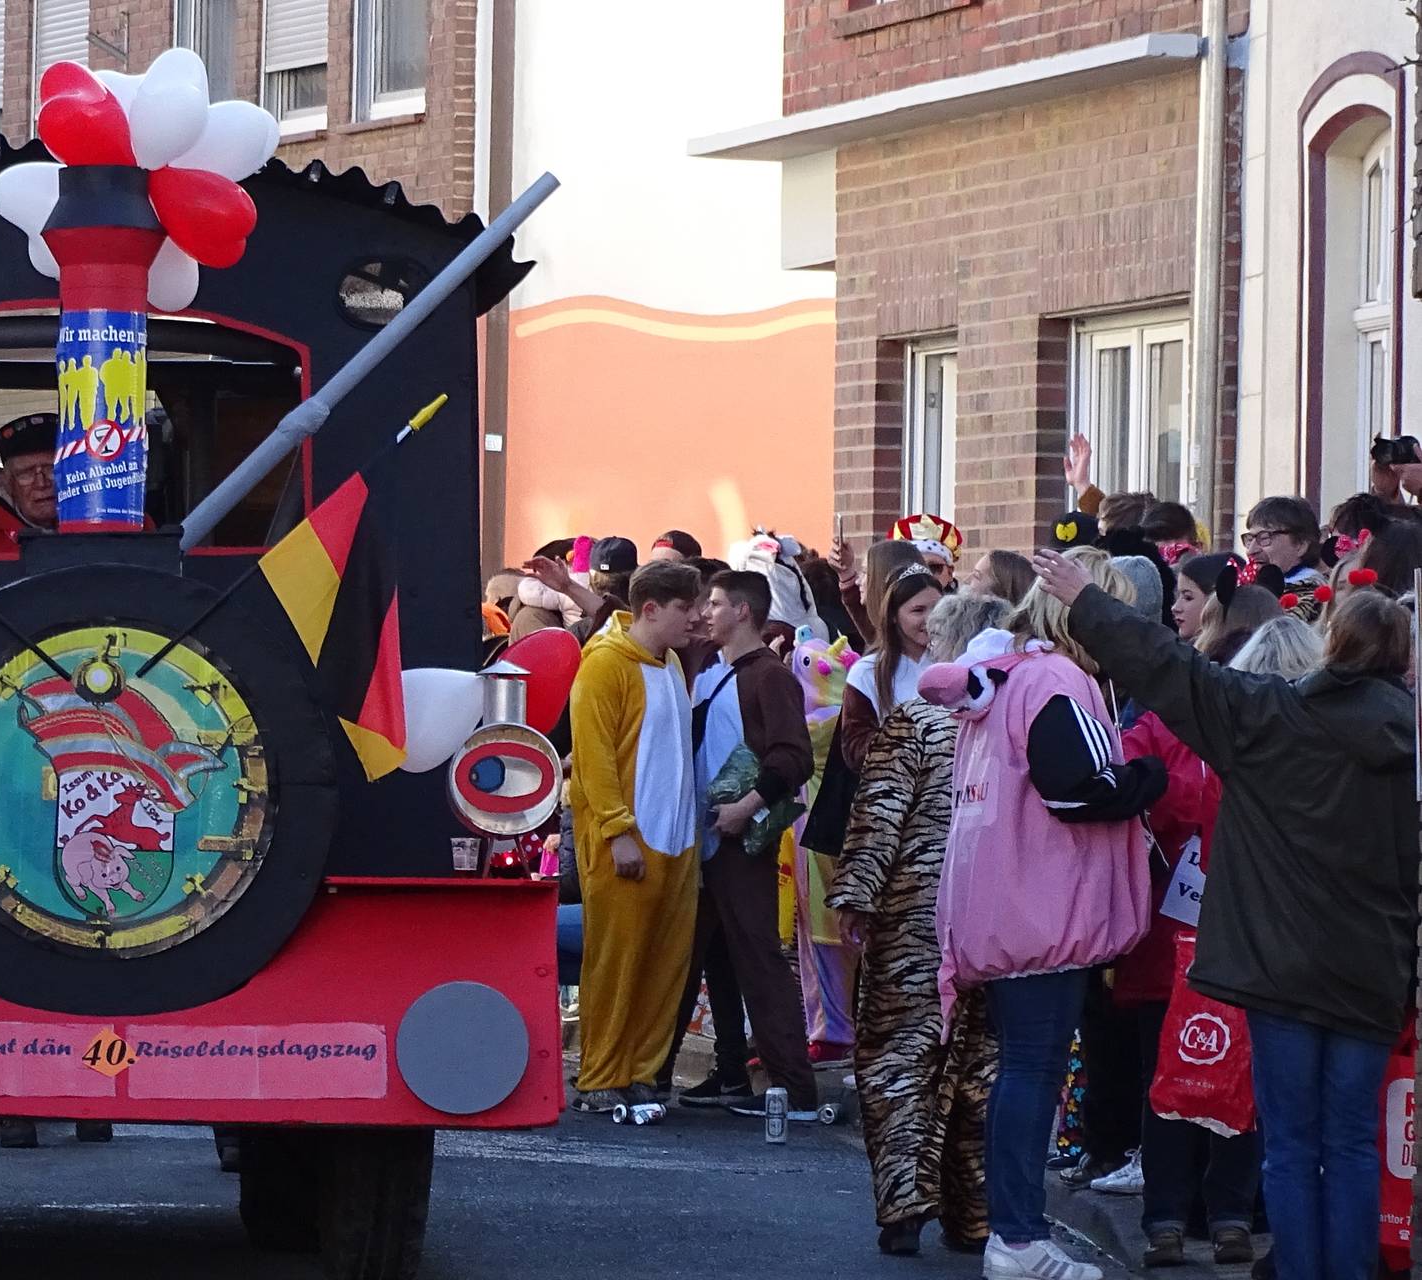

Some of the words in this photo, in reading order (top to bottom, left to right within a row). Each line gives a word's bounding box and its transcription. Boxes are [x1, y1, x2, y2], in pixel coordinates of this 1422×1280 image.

[78, 325, 135, 343] machen
[66, 471, 87, 485] Kein
[89, 461, 127, 479] Alkohol
[129, 461, 138, 471] an
[82, 480, 103, 493] und
[61, 770, 94, 795] Issum
[60, 798, 86, 820] Ko
[85, 783, 102, 801] &
[96, 772, 124, 792] Ka
[21, 1037, 72, 1057] dän
[81, 1038, 136, 1066] 40.
[135, 1039, 377, 1061] Rüseldensdagszug
[1184, 1025, 1219, 1053] C&A
